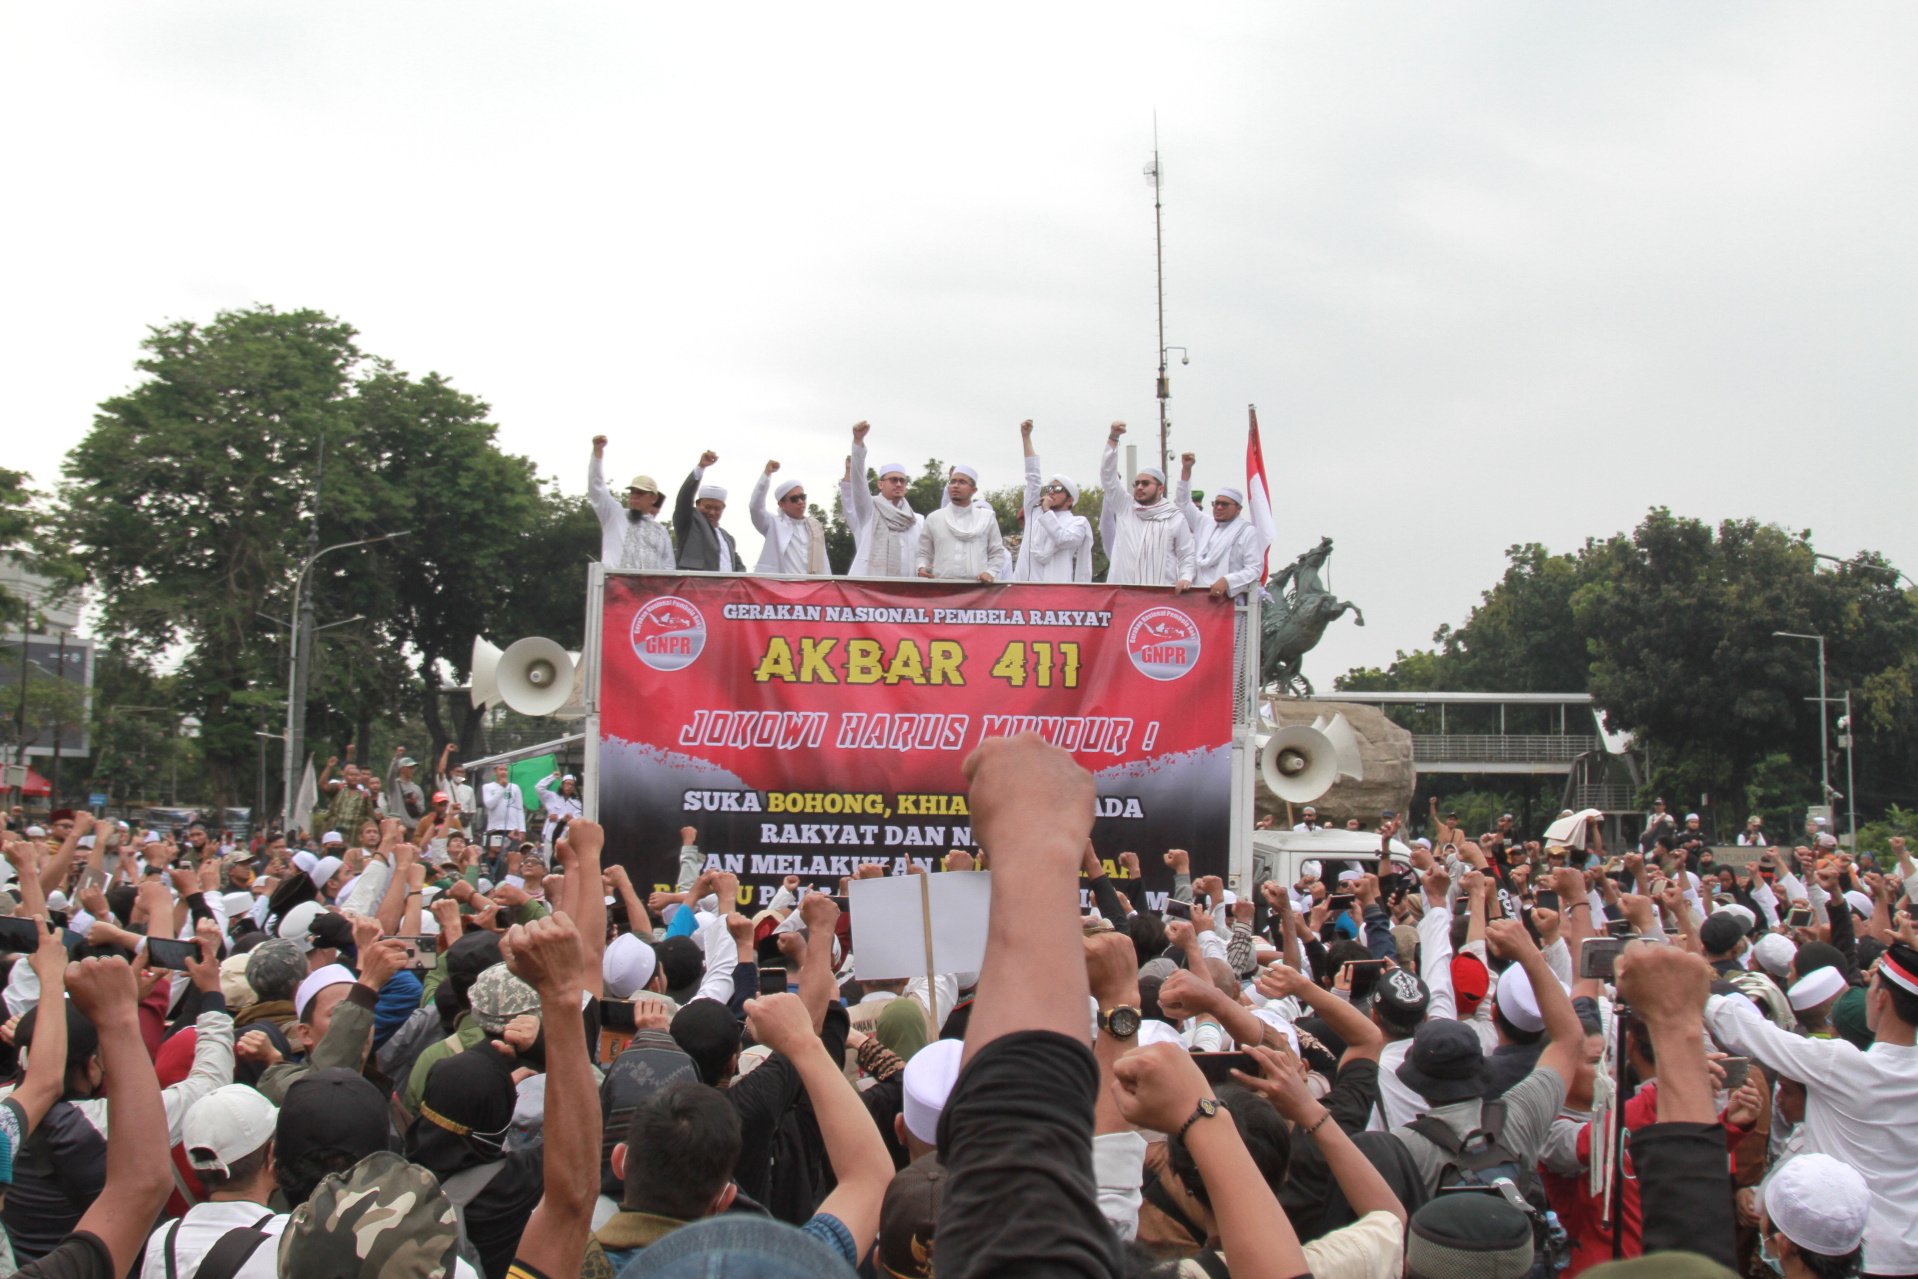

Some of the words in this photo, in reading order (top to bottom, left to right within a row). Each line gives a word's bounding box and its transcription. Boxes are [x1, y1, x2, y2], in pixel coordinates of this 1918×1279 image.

[723, 604, 821, 621] GERAKAN
[825, 606, 929, 623] NASIONAL
[933, 608, 1026, 625] PEMBELA
[1029, 610, 1112, 627] RAKYAT
[645, 635, 691, 655] GNPR
[1141, 645, 1187, 665] GNPR
[753, 637, 968, 685] AKBAR
[990, 641, 1082, 688] 411
[679, 710, 828, 750] JOKOWI
[836, 713, 969, 753] HARUS
[977, 714, 1134, 756] MUNDUR
[1142, 721, 1160, 751] !
[683, 791, 762, 812] SUKA
[768, 792, 892, 818] BOHONG,
[897, 794, 972, 815] KHIA
[760, 823, 878, 845] RAKYAT
[884, 825, 946, 846] DAN
[703, 853, 745, 874] AN
